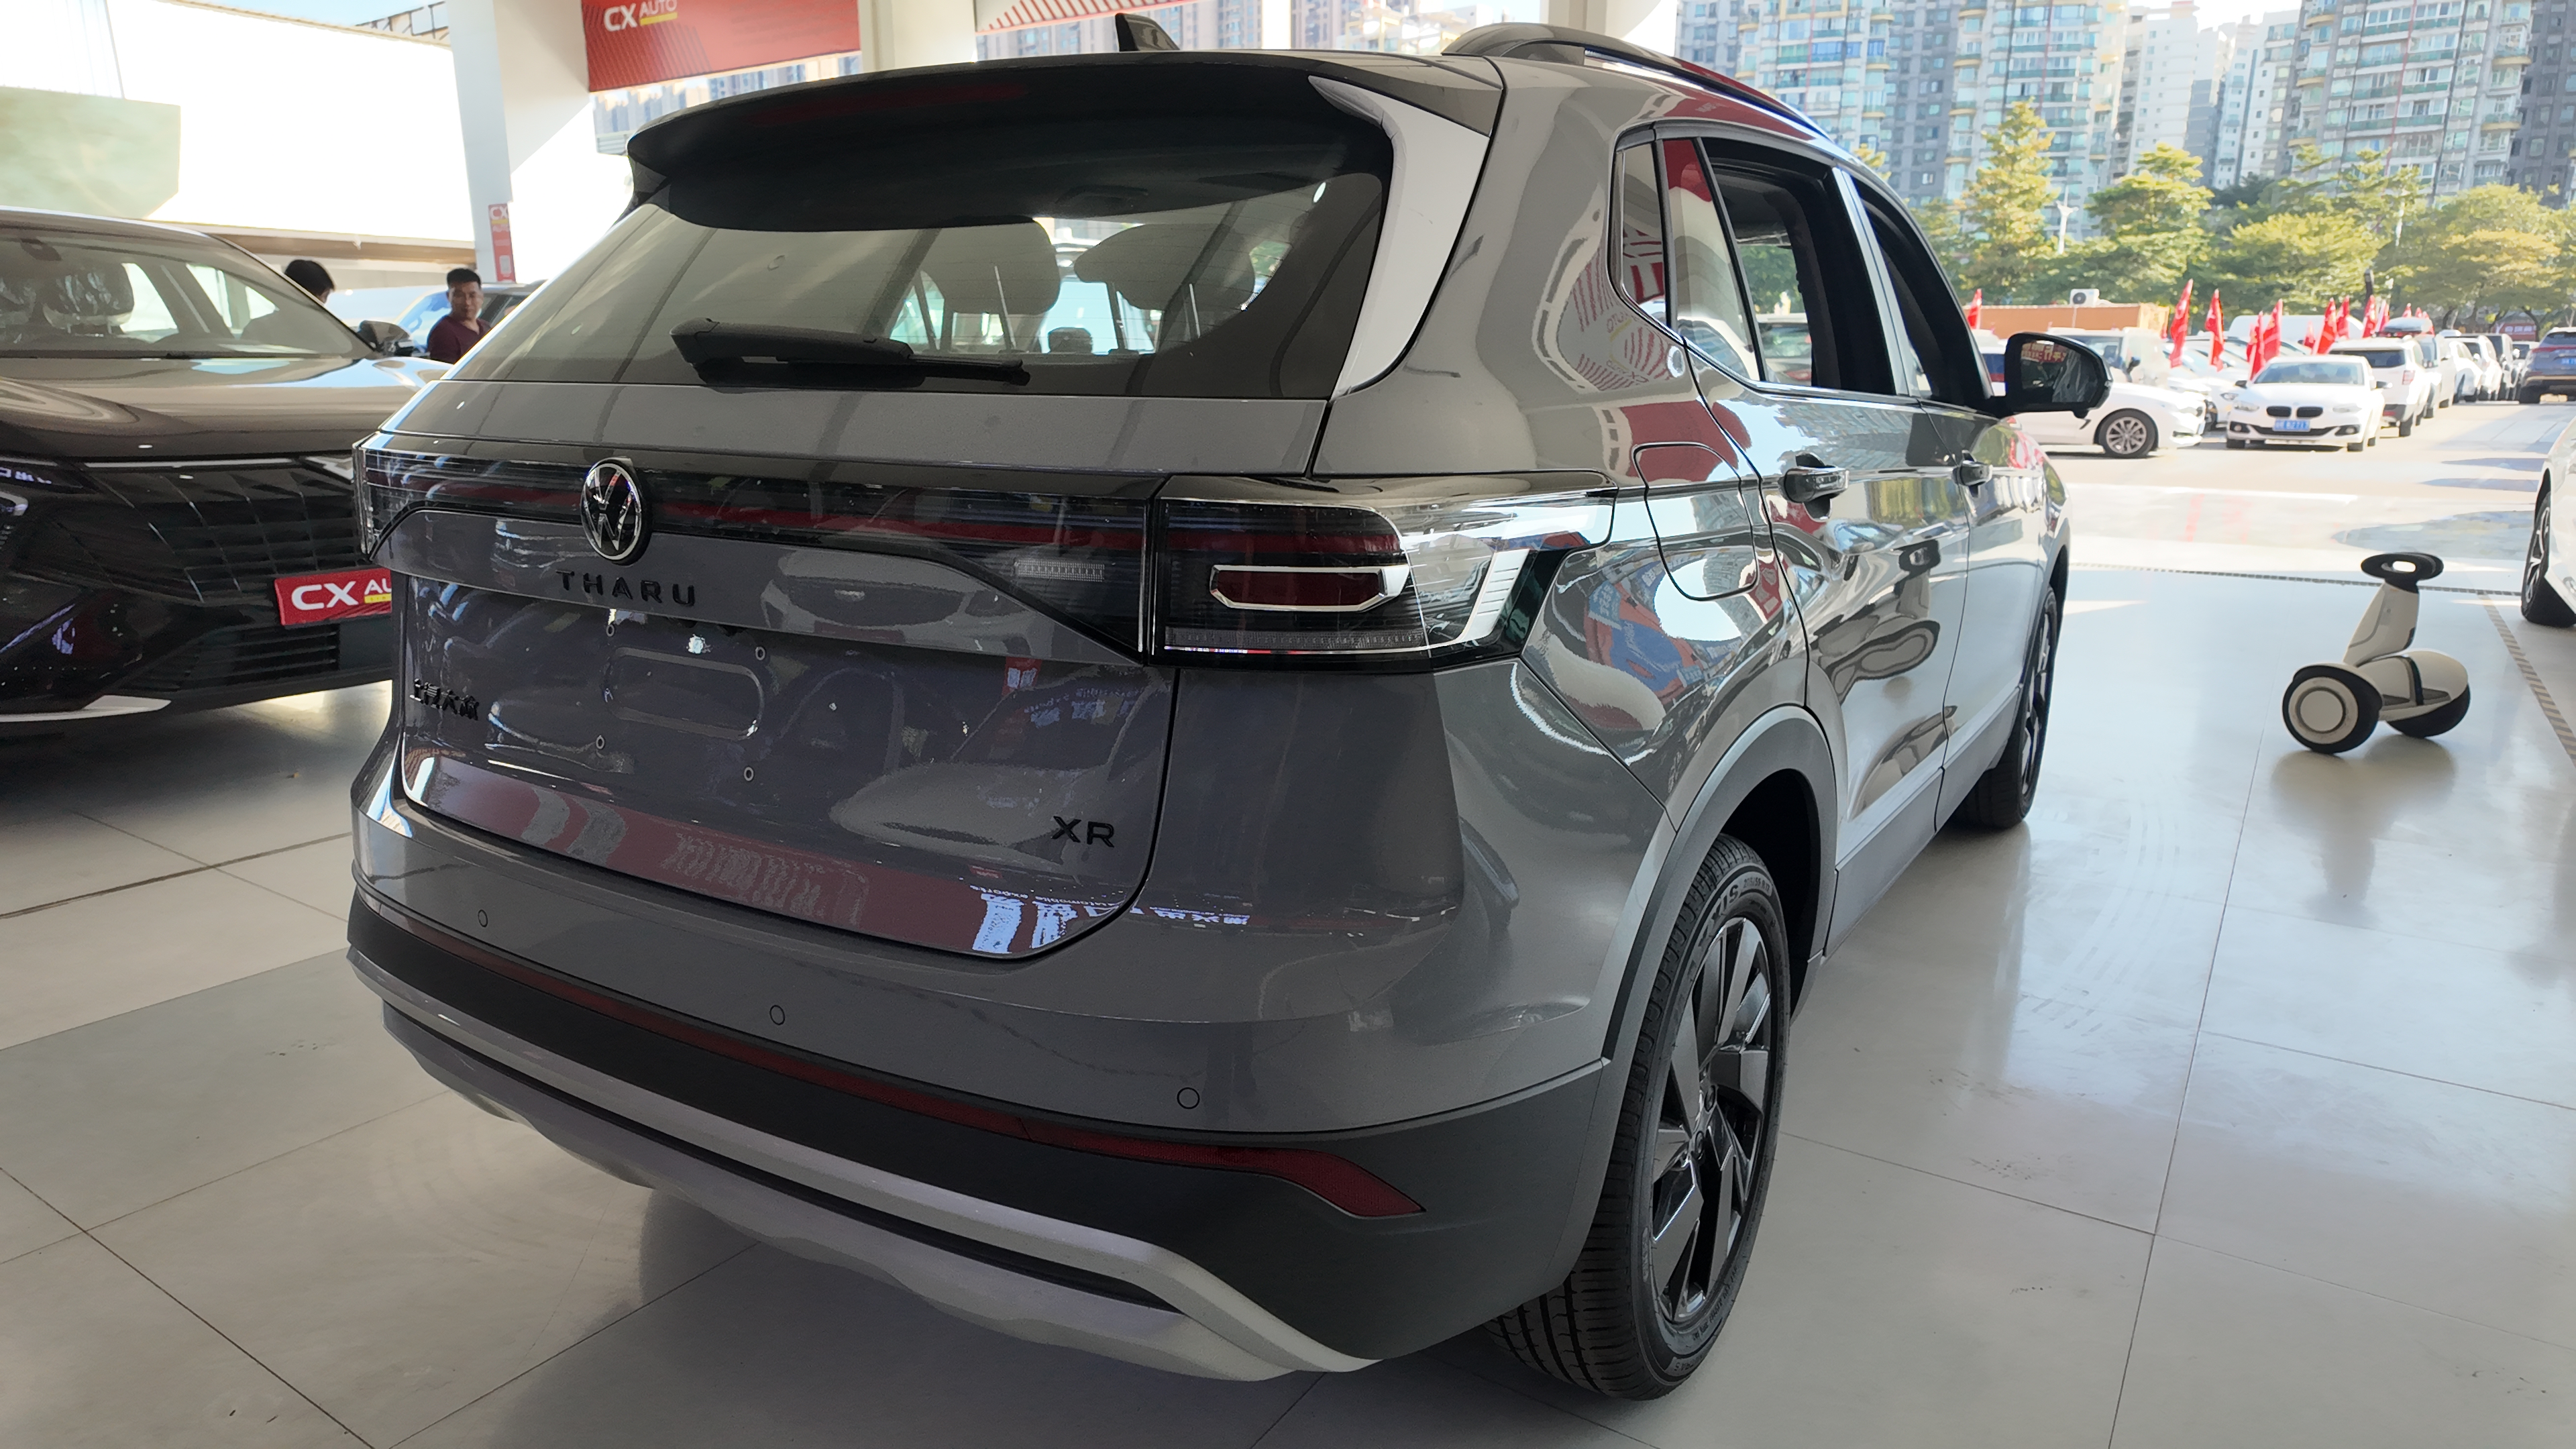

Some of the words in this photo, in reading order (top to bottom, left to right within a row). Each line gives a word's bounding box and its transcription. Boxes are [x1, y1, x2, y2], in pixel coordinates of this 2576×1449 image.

[604, 3, 638, 32] CX
[639, 0, 678, 17] AUTO
[291, 581, 359, 610] CX
[364, 578, 392, 595] AU
[555, 570, 696, 606] THARU
[1051, 815, 1115, 848] XR
